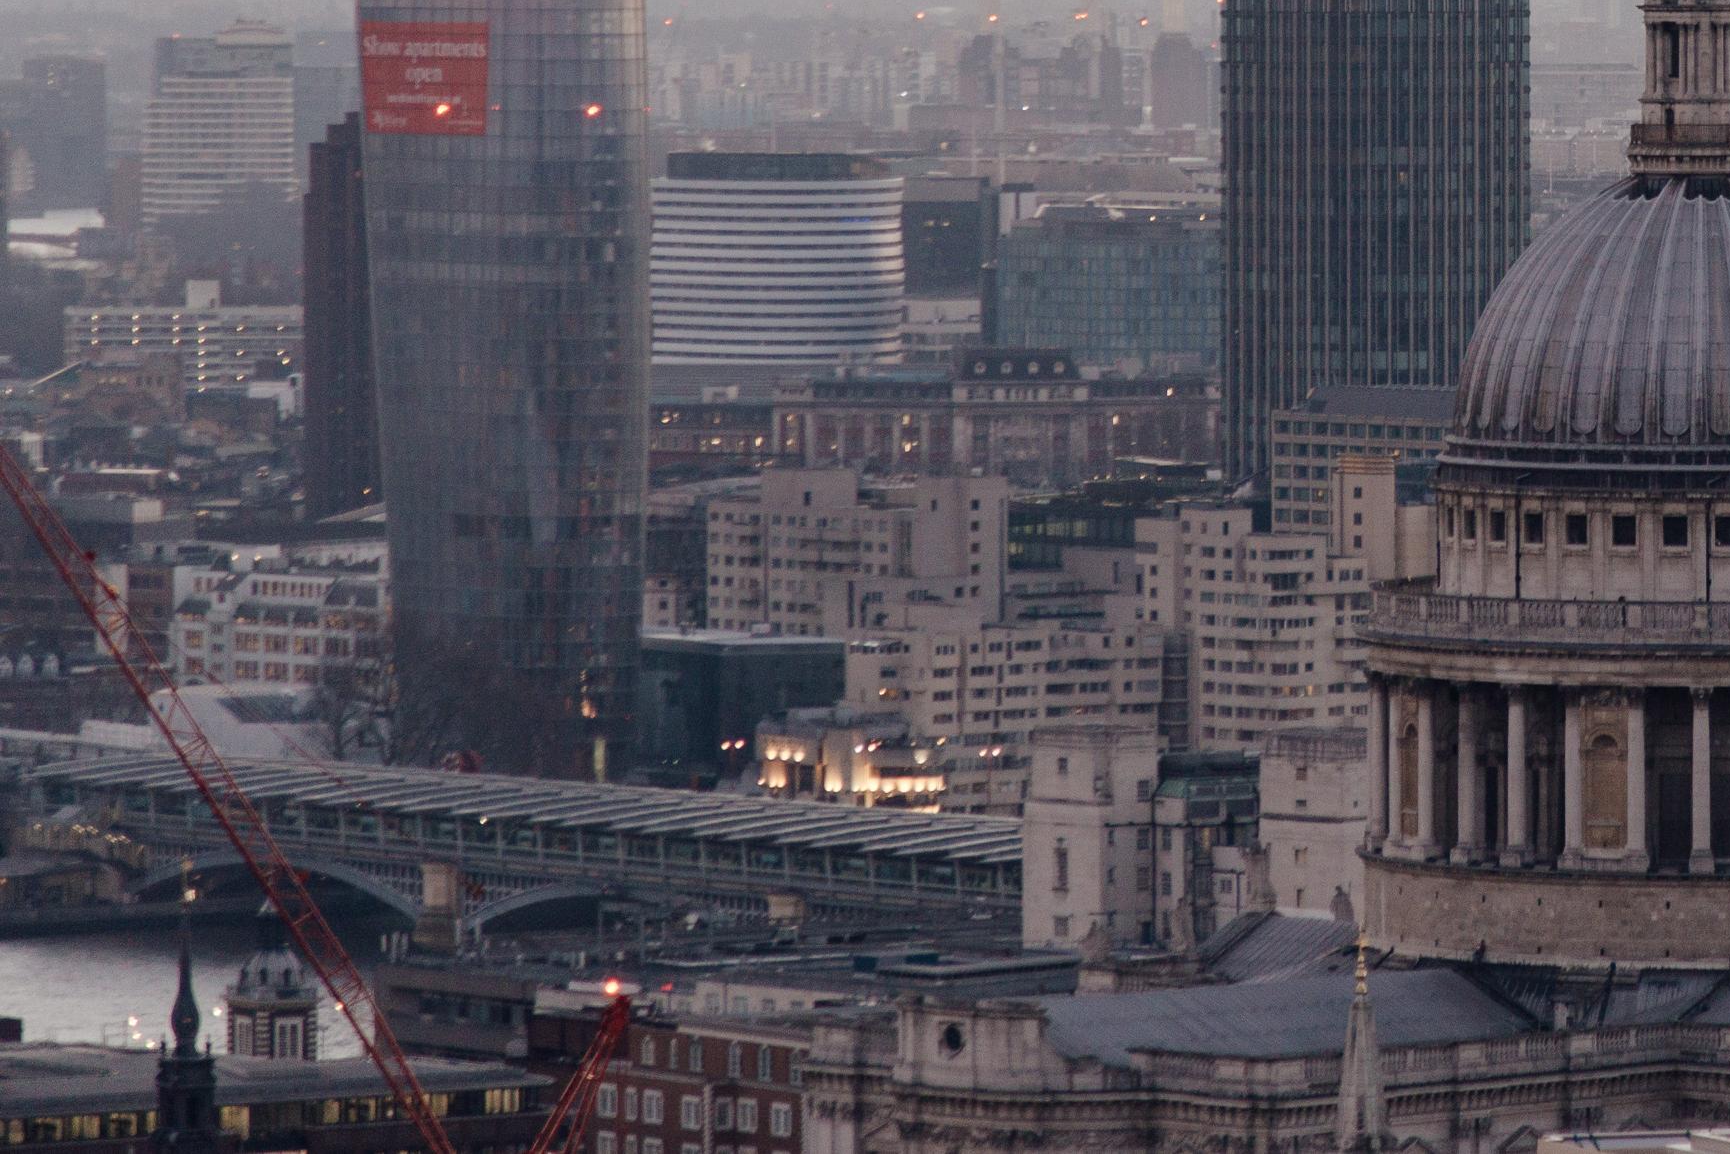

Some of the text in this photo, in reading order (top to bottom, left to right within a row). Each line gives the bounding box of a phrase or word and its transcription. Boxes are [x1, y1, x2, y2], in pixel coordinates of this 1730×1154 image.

[364, 34, 487, 63] Show apartments
[405, 67, 443, 89] open
